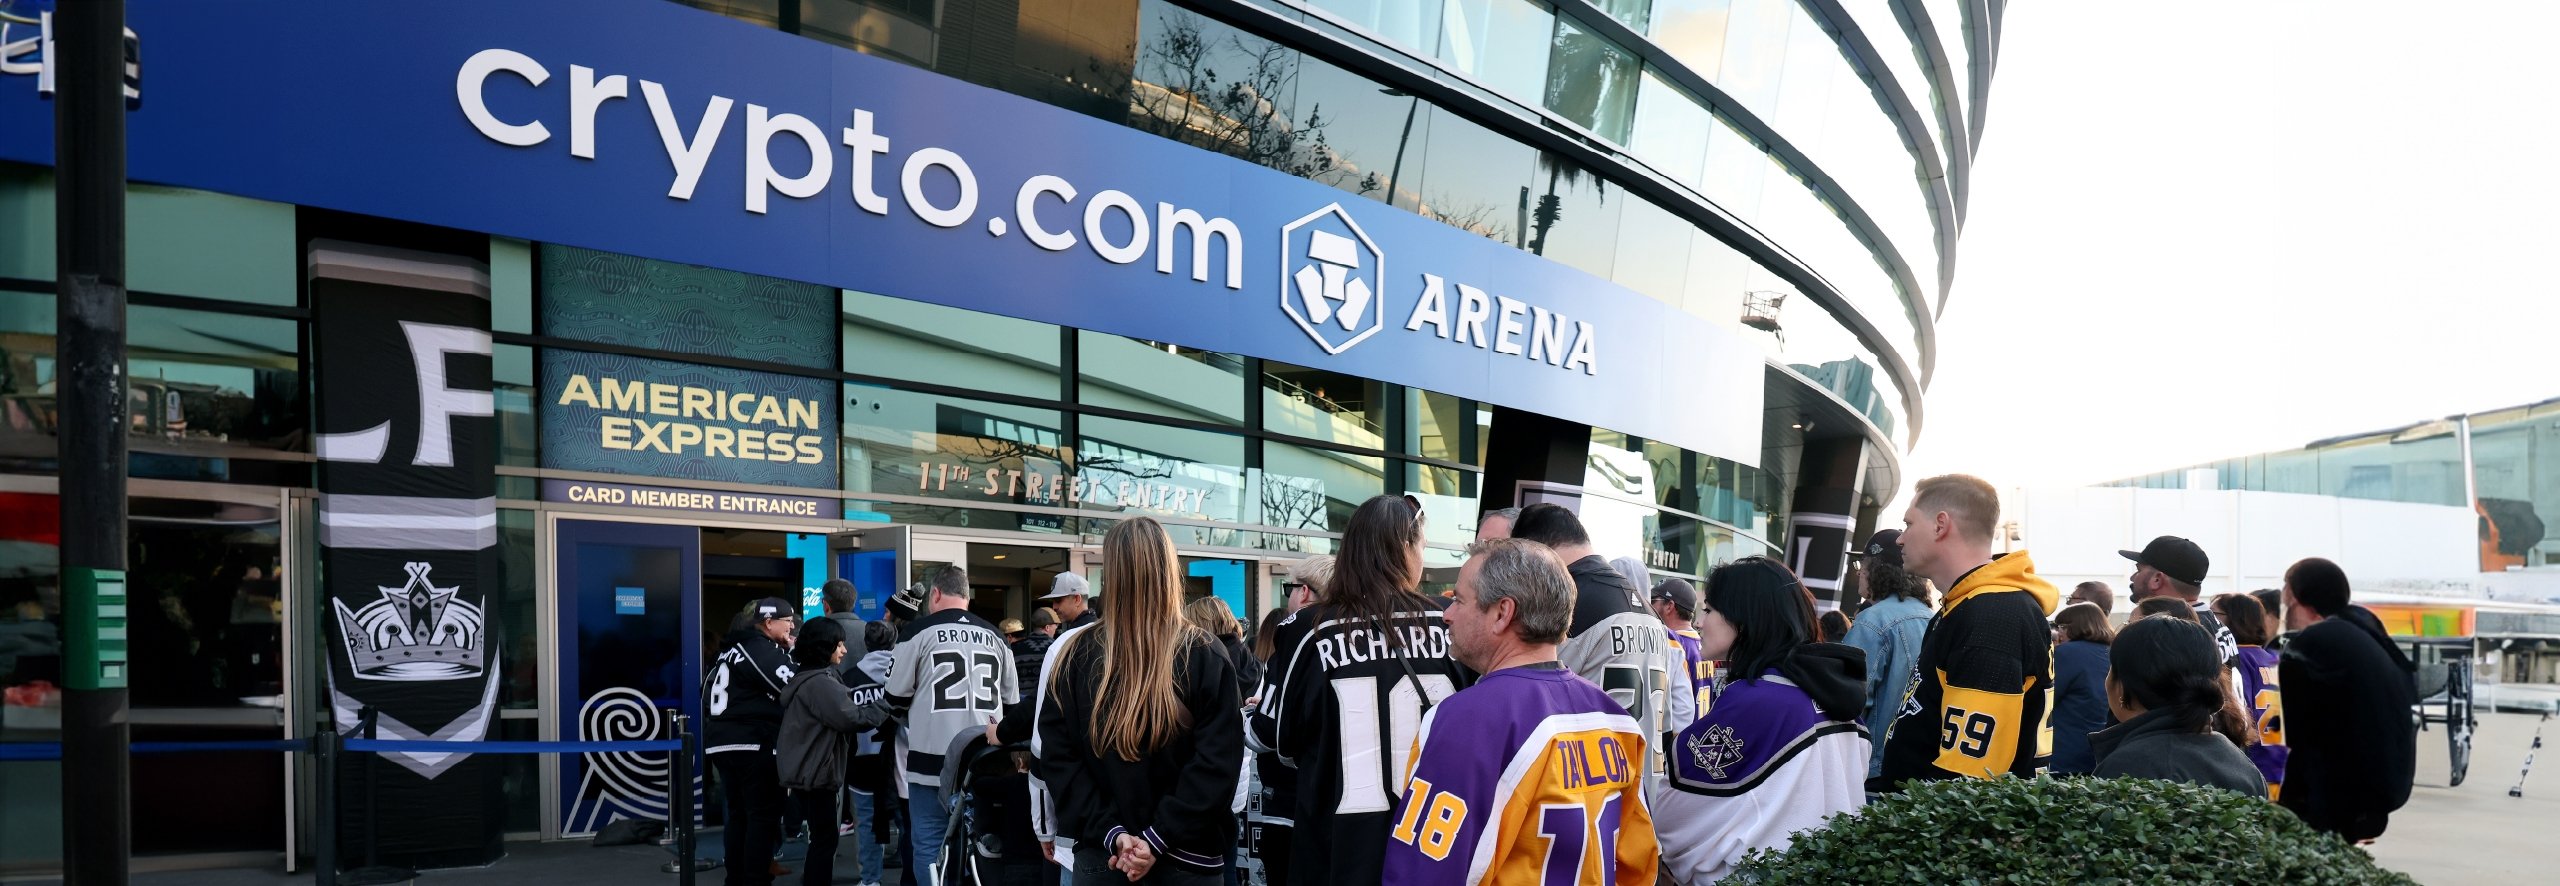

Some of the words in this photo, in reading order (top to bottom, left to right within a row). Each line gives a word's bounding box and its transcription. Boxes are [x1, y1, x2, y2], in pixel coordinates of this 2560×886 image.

[456, 47, 1243, 291] crypto.com
[1404, 272, 1597, 376] ARENA
[558, 373, 819, 430] AMERICAN
[601, 416, 824, 465] EXPRESS
[568, 485, 626, 505] CARD
[631, 490, 715, 510] MEMBER
[720, 498, 817, 516] ENTRANCE
[983, 467, 1101, 504] STREET
[1117, 480, 1207, 514] ENTRY
[960, 510, 969, 527] 5
[1653, 548, 1681, 570] ENTRY
[936, 628, 995, 649] BROWN
[930, 649, 1001, 714] 23
[1329, 673, 1458, 815] 10
[1940, 704, 1996, 759] 59
[1557, 736, 1631, 790] TAYLOR
[1391, 776, 1469, 863] 18
